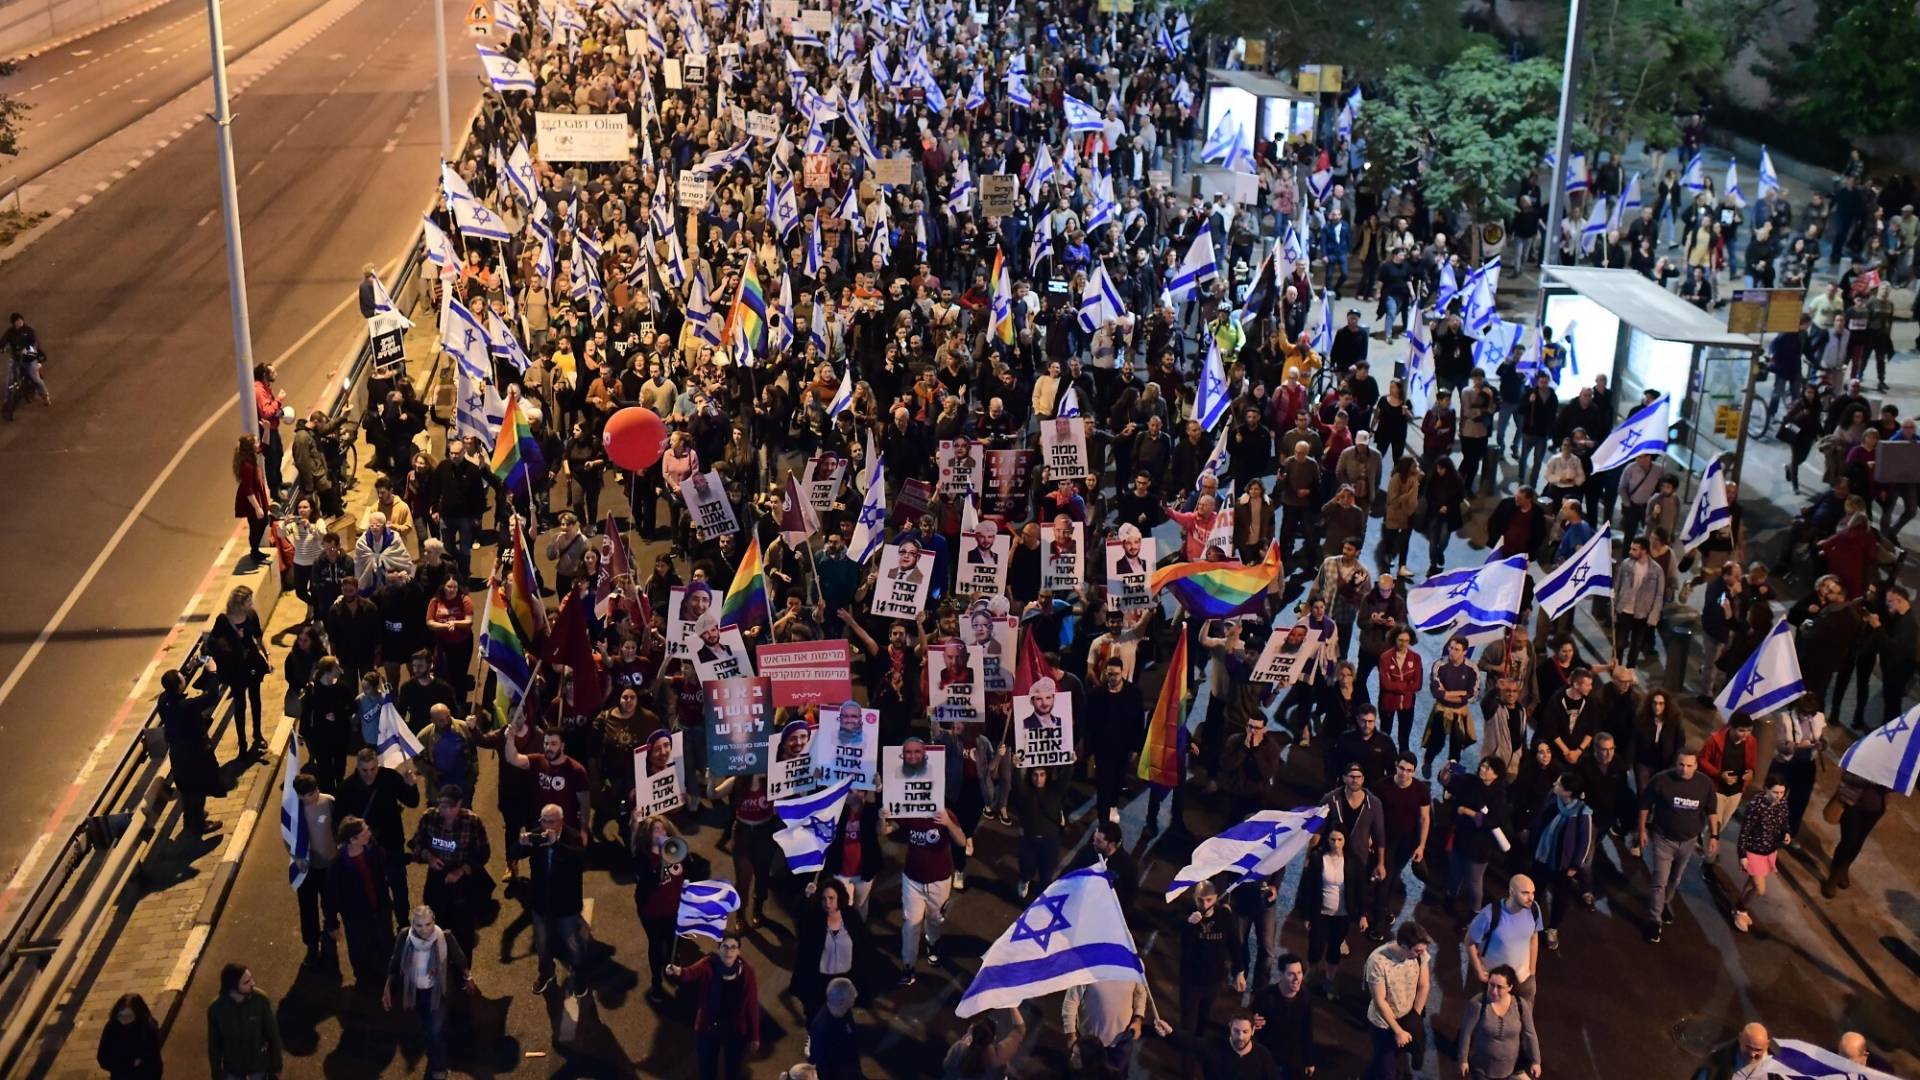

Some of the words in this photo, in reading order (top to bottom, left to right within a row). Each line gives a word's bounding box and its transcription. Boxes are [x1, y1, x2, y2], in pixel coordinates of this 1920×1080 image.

[558, 120, 588, 128] LGBT
[594, 118, 623, 130] Olim
[1052, 445, 1077, 454] ממה
[1052, 456, 1078, 465] אתה
[1045, 465, 1084, 476] מפחד
[699, 501, 722, 514] ממה
[702, 510, 726, 525] אתה
[697, 520, 734, 536] מפחד
[894, 582, 917, 592] ממה
[892, 592, 914, 602] אתה
[764, 655, 790, 664] הראש
[811, 651, 844, 660] מרימות
[814, 670, 846, 678] מרימות
[714, 704, 764, 720] חושך
[715, 718, 764, 735] לגרש
[1029, 728, 1062, 739] ממה
[1028, 739, 1062, 752] אתה
[1017, 749, 1070, 766] מפחד?
[905, 781, 932, 790] ממה
[904, 792, 931, 800] אתה
